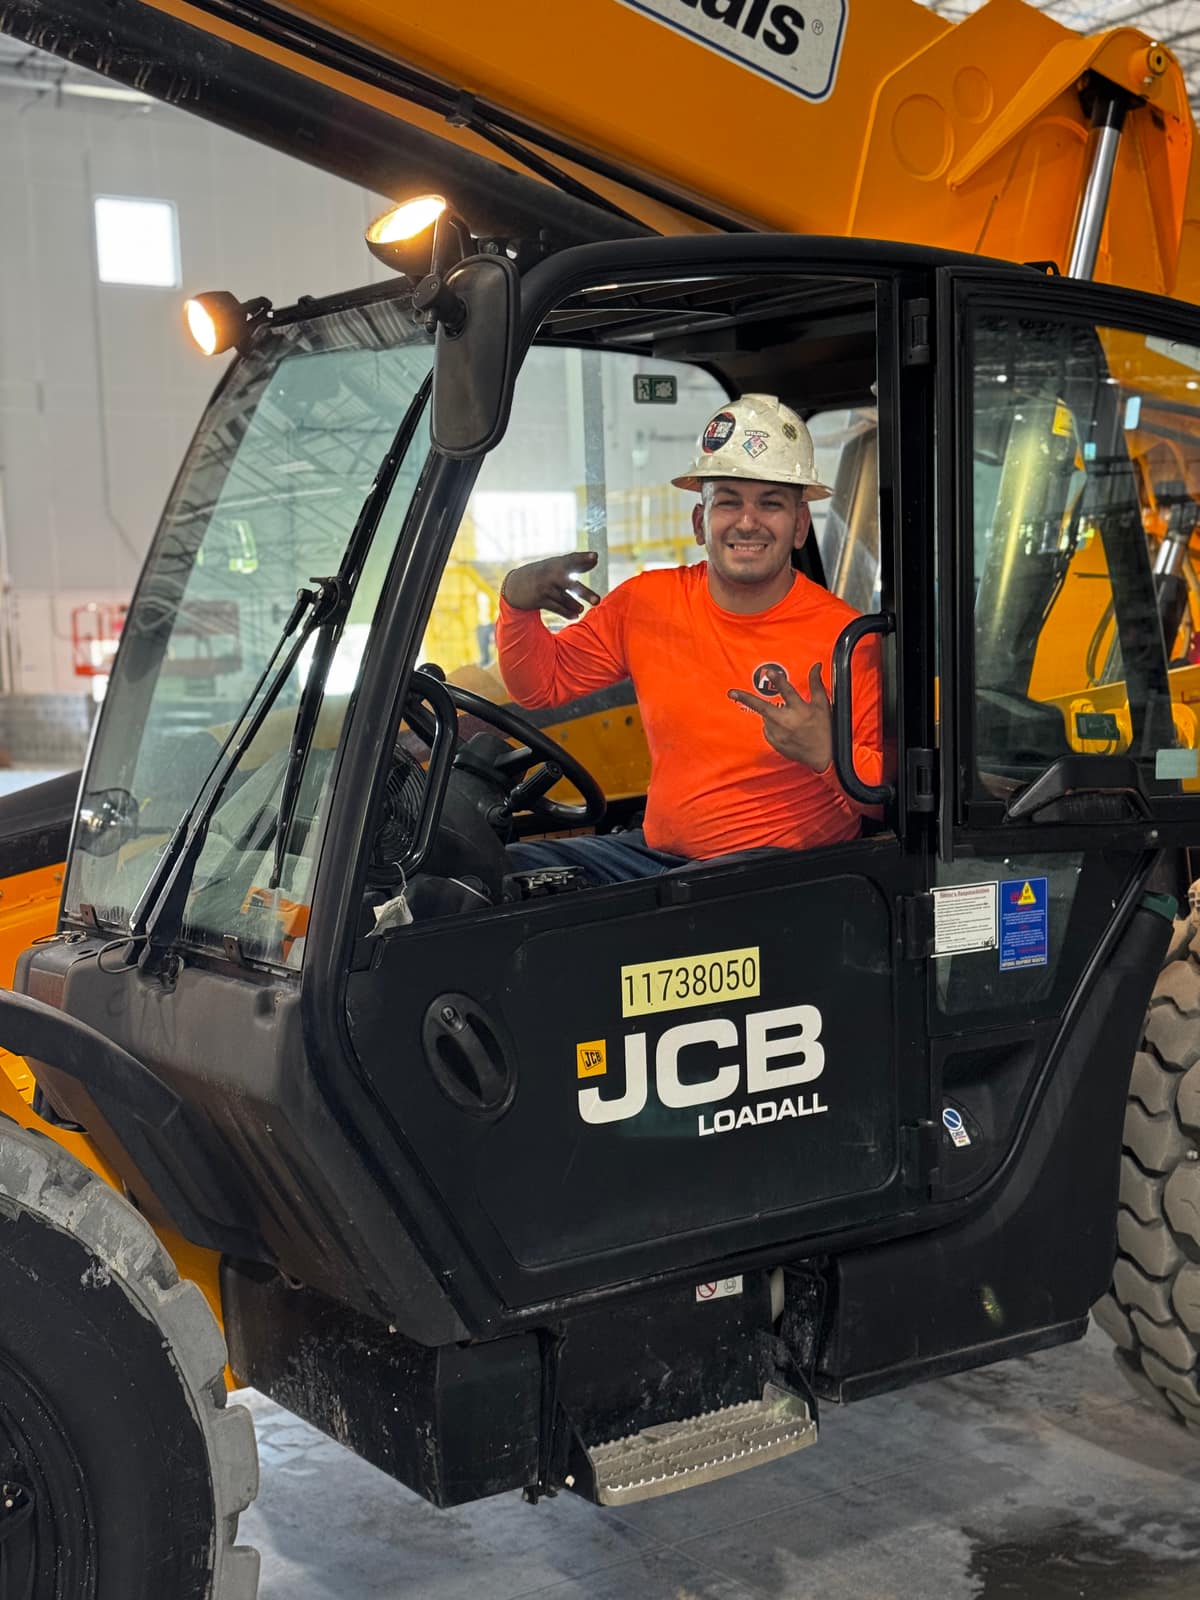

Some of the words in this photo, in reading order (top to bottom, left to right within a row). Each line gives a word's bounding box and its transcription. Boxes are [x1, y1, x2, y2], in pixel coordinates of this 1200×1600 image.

[680, 0, 805, 56] als
[624, 957, 756, 1007] 11738050
[578, 1004, 826, 1125] JCB
[584, 1050, 602, 1068] JCB
[698, 1093, 828, 1137] LOADALL
